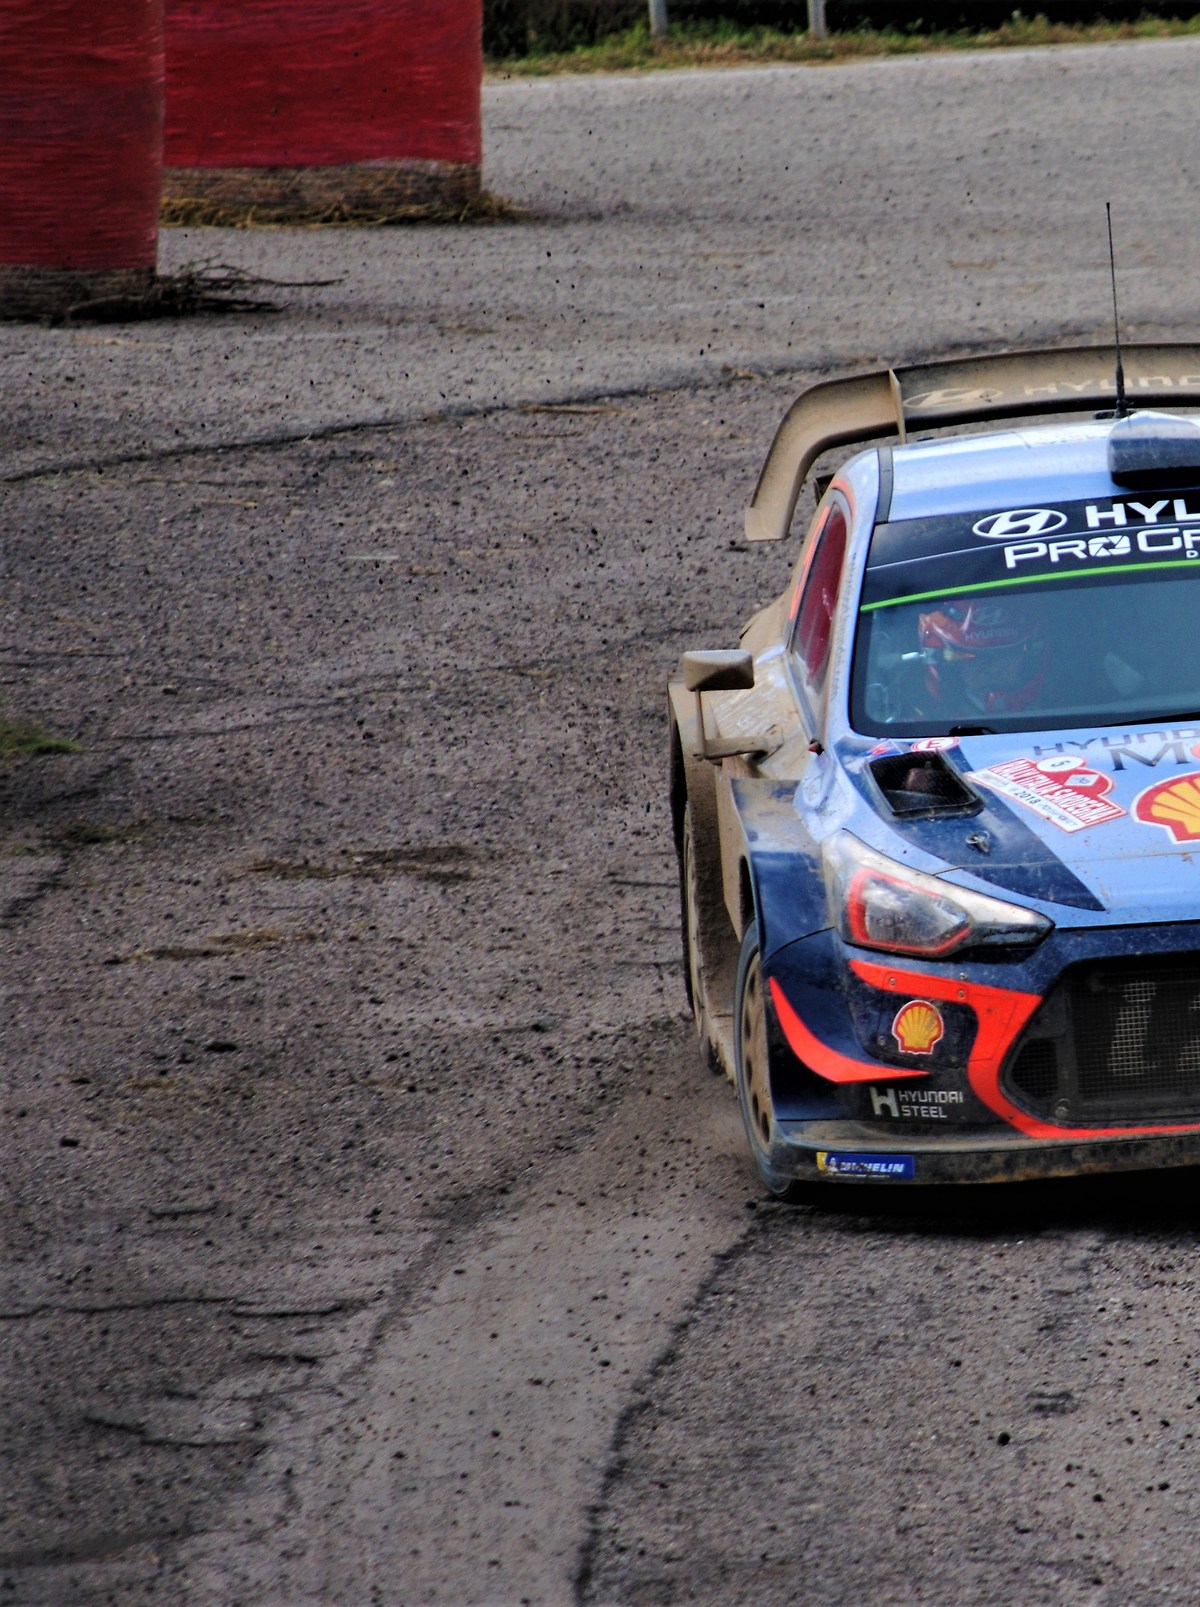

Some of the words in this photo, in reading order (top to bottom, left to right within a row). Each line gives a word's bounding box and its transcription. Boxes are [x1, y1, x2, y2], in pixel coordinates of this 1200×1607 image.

[1013, 789, 1042, 805] 2018
[898, 1090, 964, 1103] HYUNDAI
[901, 1105, 948, 1118] STEEL
